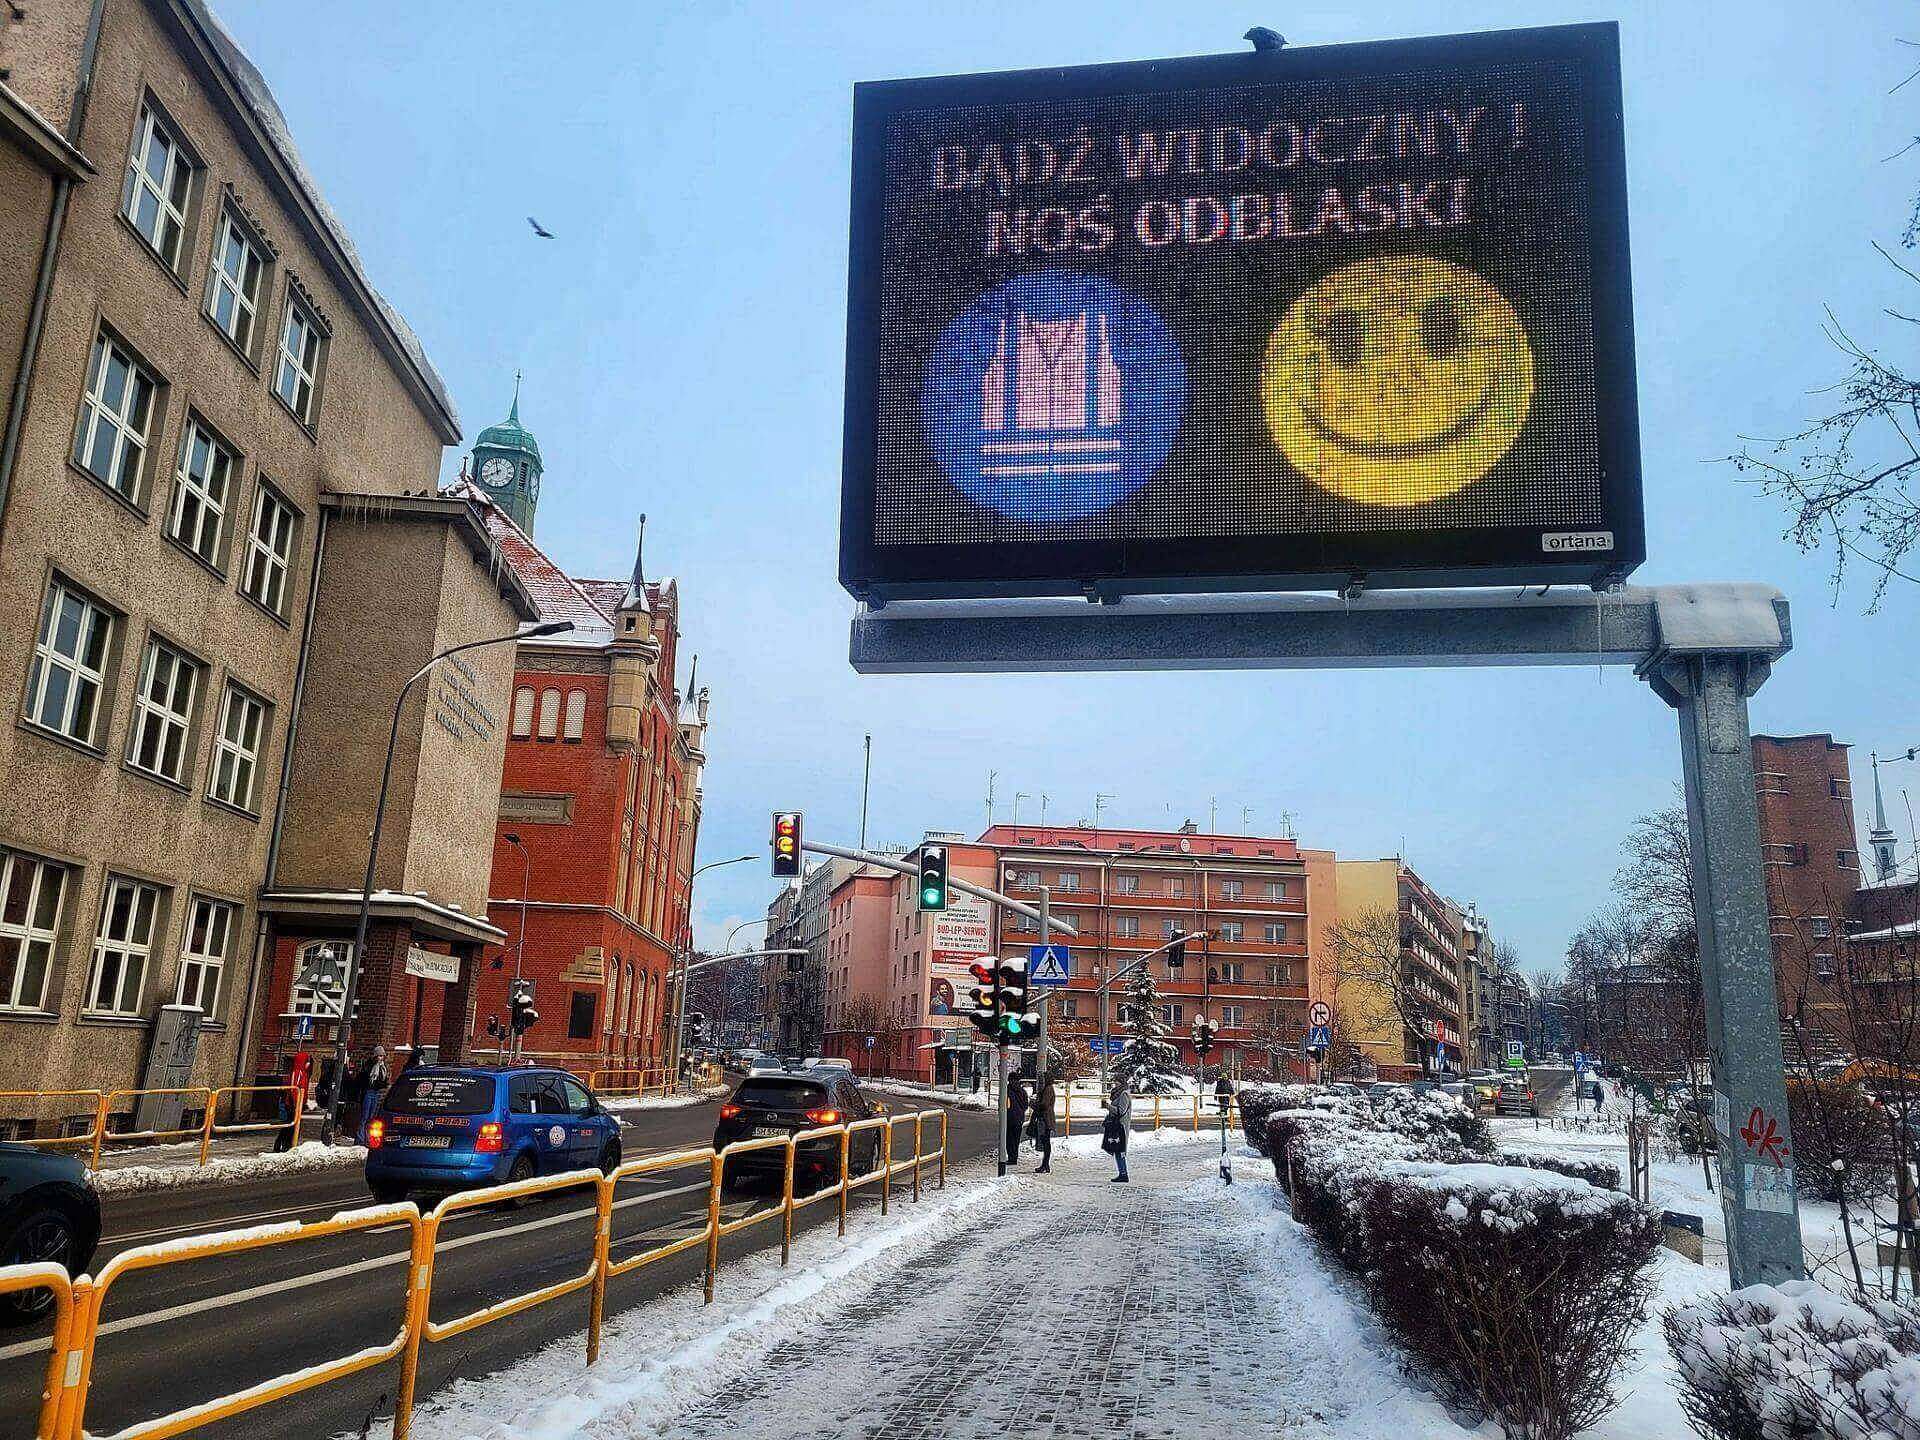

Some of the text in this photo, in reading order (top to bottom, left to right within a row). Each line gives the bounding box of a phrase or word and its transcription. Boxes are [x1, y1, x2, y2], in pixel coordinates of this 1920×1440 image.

[1116, 106, 1487, 179] WIDOCZNY
[1511, 102, 1527, 153] !
[986, 179, 1472, 257] NOŚ ODBLASKI
[1549, 535, 1608, 549] ortana
